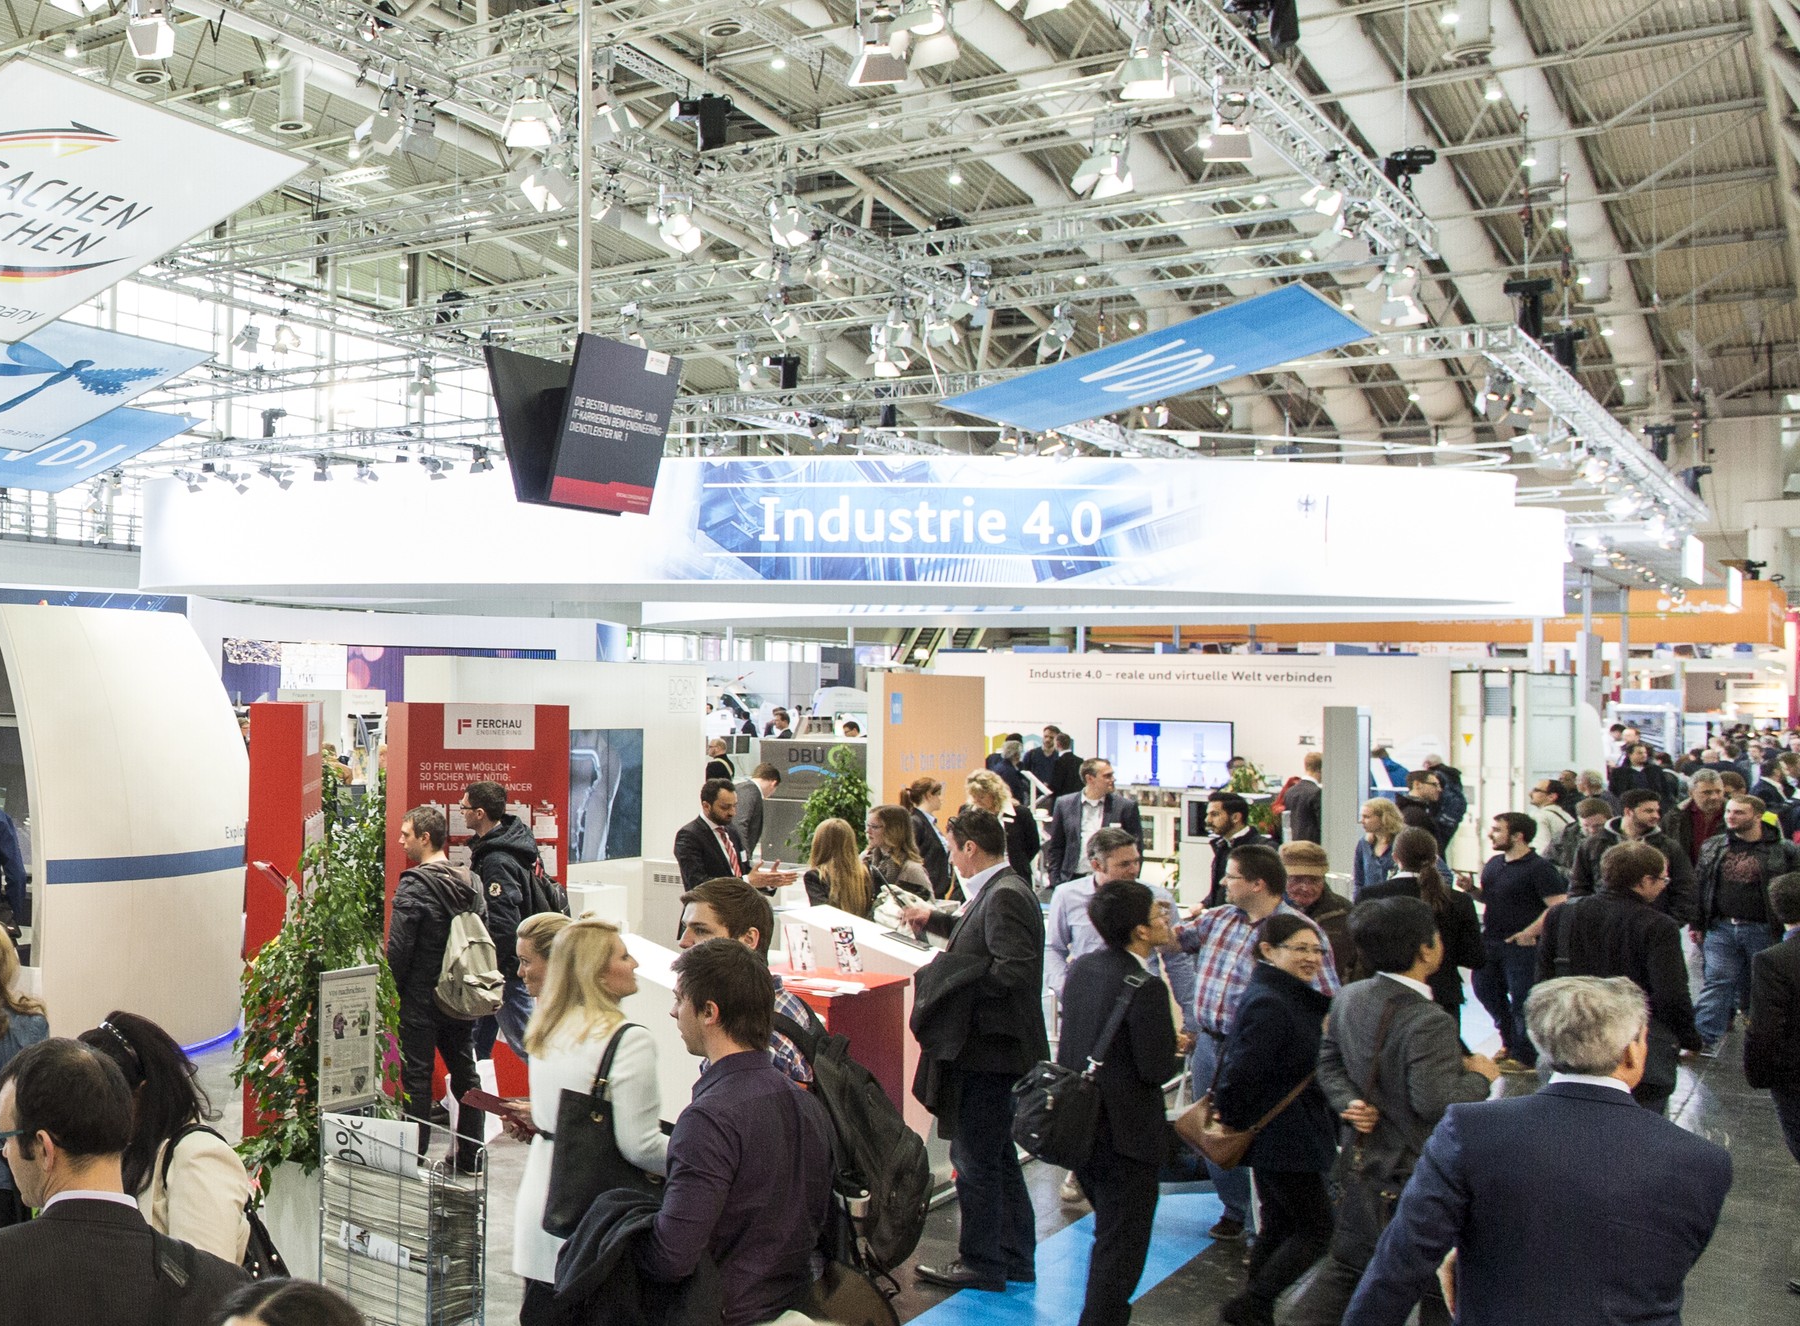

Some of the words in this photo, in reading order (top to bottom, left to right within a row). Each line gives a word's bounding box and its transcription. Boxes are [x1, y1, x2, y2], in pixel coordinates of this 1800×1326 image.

[574, 396, 586, 407] DIE
[585, 398, 609, 413] BESTEN
[609, 403, 645, 420] INGENIEURS-
[645, 411, 658, 423] UND
[569, 421, 614, 439] DIENSTLEISTER
[613, 430, 623, 442] NR.
[571, 409, 612, 426] IT-KARRIEREN
[611, 417, 626, 429] BEIM
[625, 420, 664, 437] ENGINEERING-
[2, 437, 127, 470] VDI
[758, 495, 1007, 544] Industrie
[1022, 500, 1102, 546] 4.0
[1029, 669, 1082, 680] Industrie
[1085, 670, 1102, 680] 4.0
[1115, 669, 1145, 681] reale
[1149, 670, 1172, 681] und
[1175, 670, 1228, 682] virtuelle
[1232, 671, 1262, 682] Welt
[1265, 671, 1332, 683] verbinden
[476, 719, 522, 728] FERCHAU
[420, 762, 431, 771] SO
[434, 762, 452, 771] FREI
[454, 762, 470, 771] WIE
[472, 761, 510, 771] MÖGLICH
[420, 773, 431, 781] SO
[434, 773, 464, 781] SICHER
[466, 773, 481, 781] WIE
[484, 772, 512, 782] NÖTIG:
[420, 783, 434, 791] IHR
[437, 783, 458, 791] PLUS
[505, 783, 532, 791] ANCER
